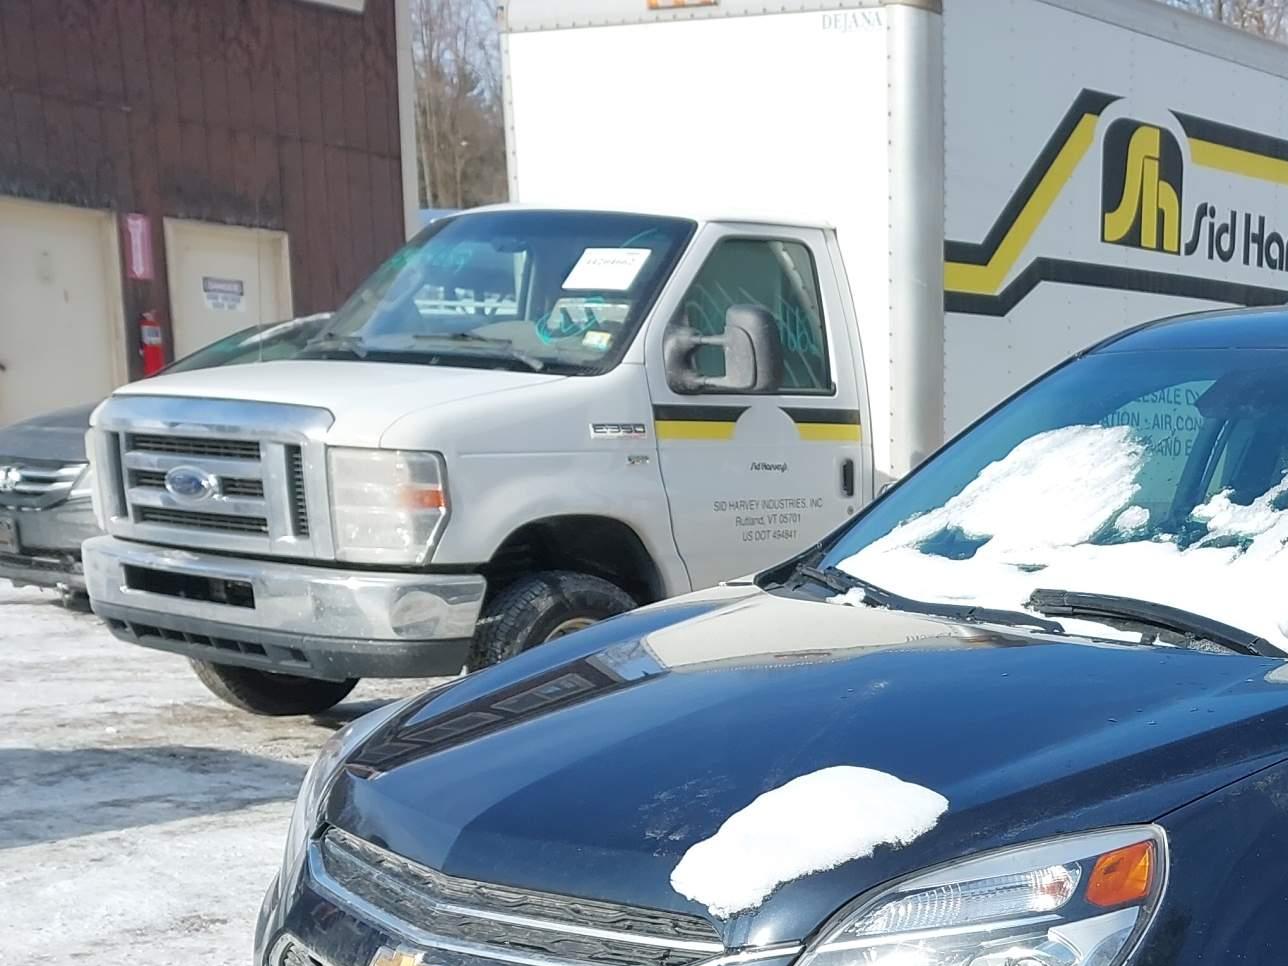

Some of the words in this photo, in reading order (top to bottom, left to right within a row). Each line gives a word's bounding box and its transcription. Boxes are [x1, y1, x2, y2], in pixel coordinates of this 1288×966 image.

[1184, 202, 1237, 262] Sid
[1152, 413, 1172, 430] AIR
[728, 500, 760, 511] HARVEY
[767, 514, 778, 525] VT
[779, 513, 801, 524] 05701
[755, 530, 771, 541] DOT
